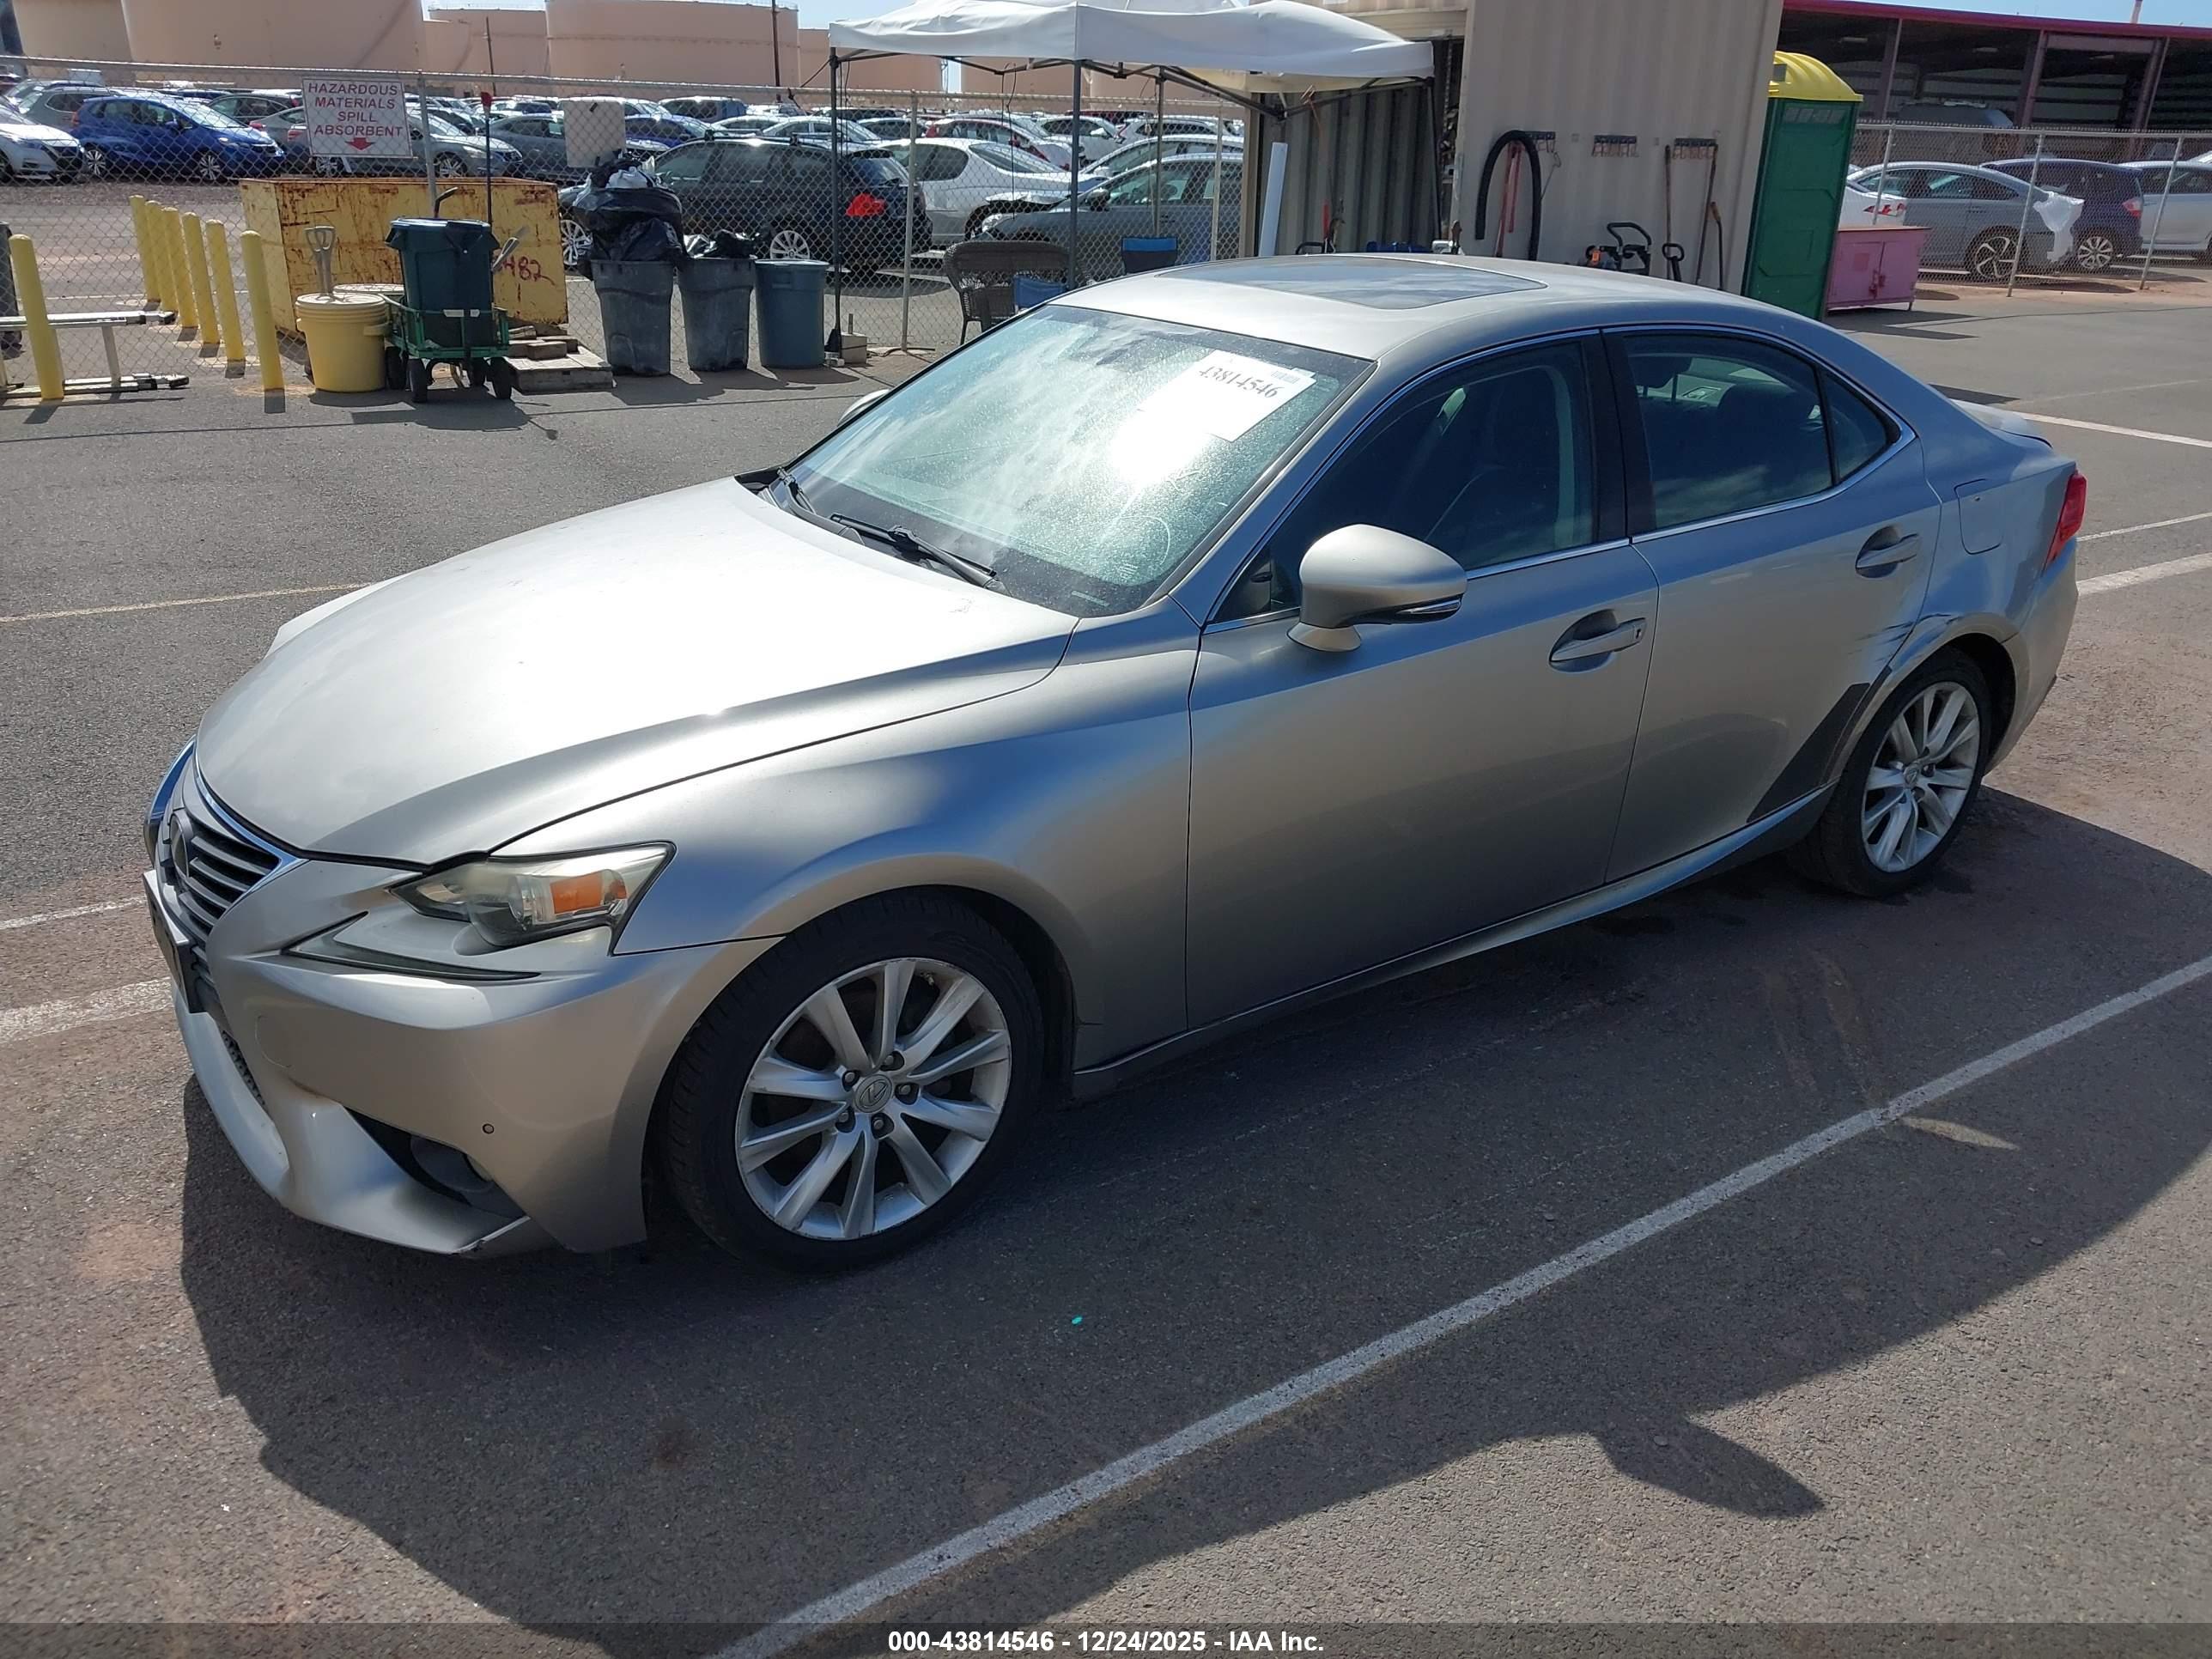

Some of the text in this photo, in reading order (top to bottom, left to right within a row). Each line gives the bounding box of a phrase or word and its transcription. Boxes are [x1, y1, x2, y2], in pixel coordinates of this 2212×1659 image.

[309, 82, 398, 95] HAZARDOUS
[315, 97, 395, 109] MATERIALS
[337, 111, 378, 122] SPILL
[314, 125, 403, 137] ABSORBENT
[1199, 366, 1285, 398] 43814546
